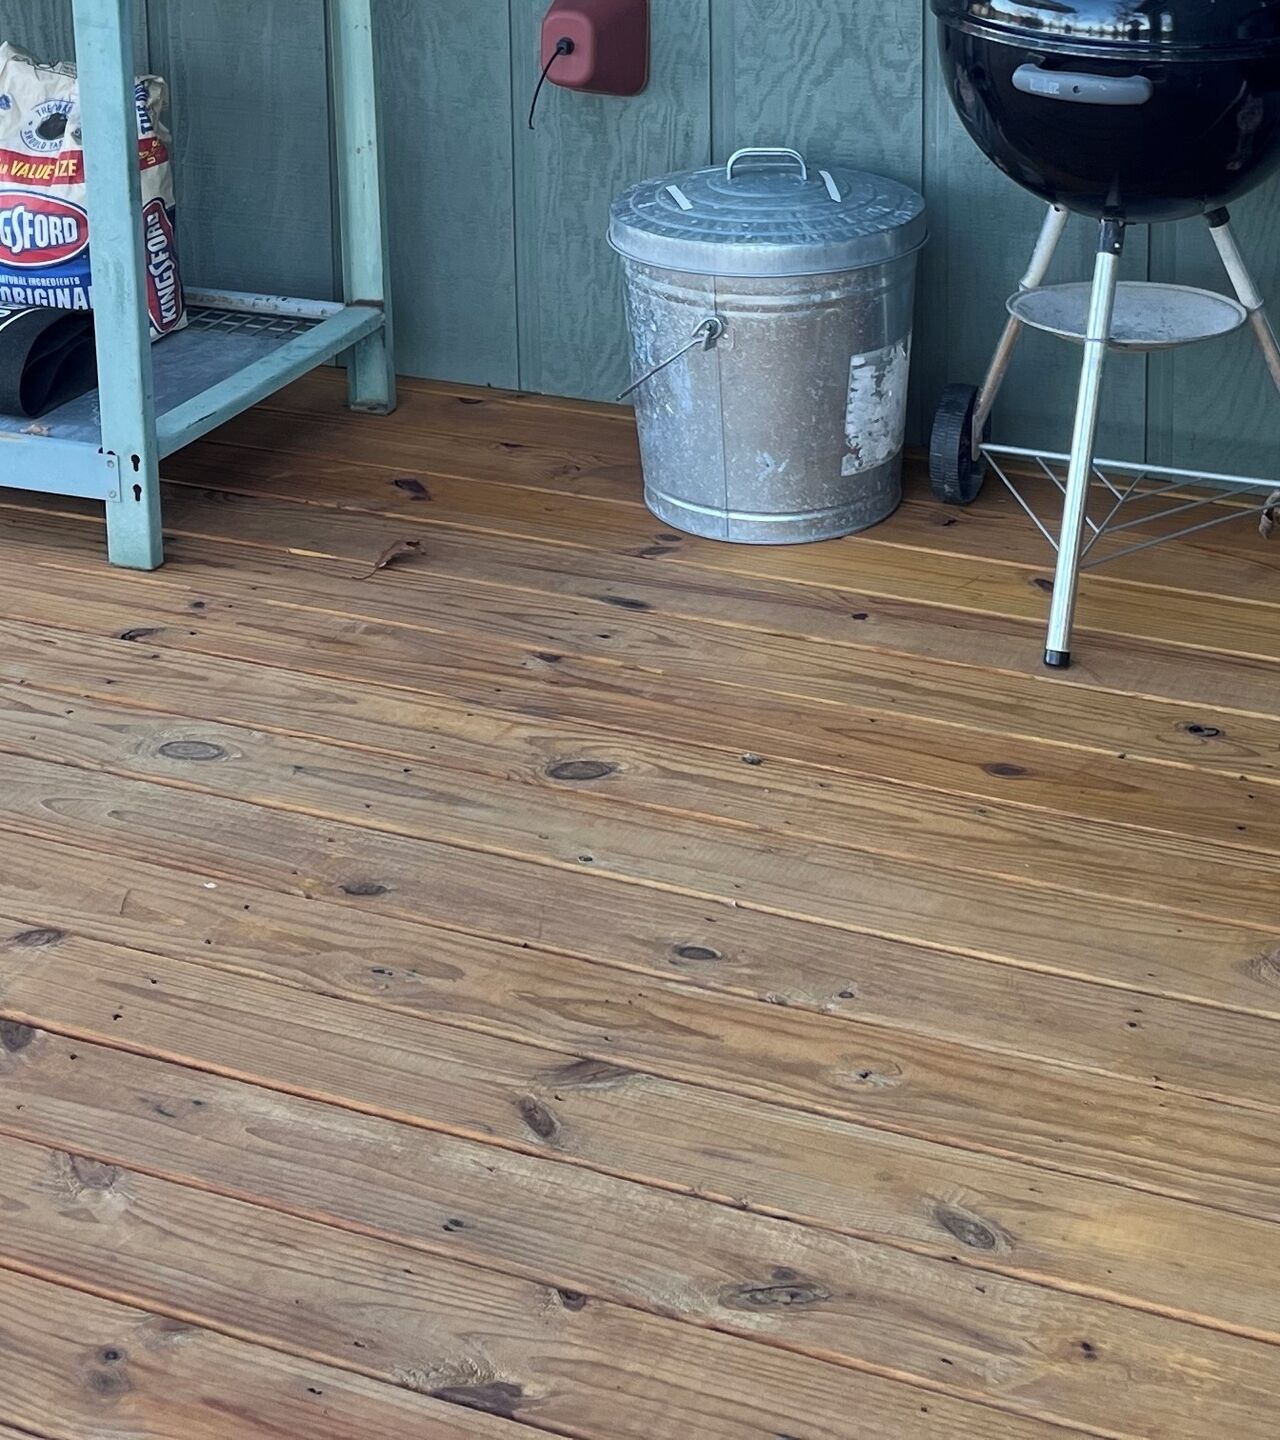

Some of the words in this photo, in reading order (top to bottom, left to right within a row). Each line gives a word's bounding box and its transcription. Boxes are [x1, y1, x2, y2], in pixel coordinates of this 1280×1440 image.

[11, 160, 55, 180] VALUE
[54, 159, 78, 177] IZE
[146, 211, 177, 324] KINGSFORD
[28, 276, 81, 287] INGREDIENTS
